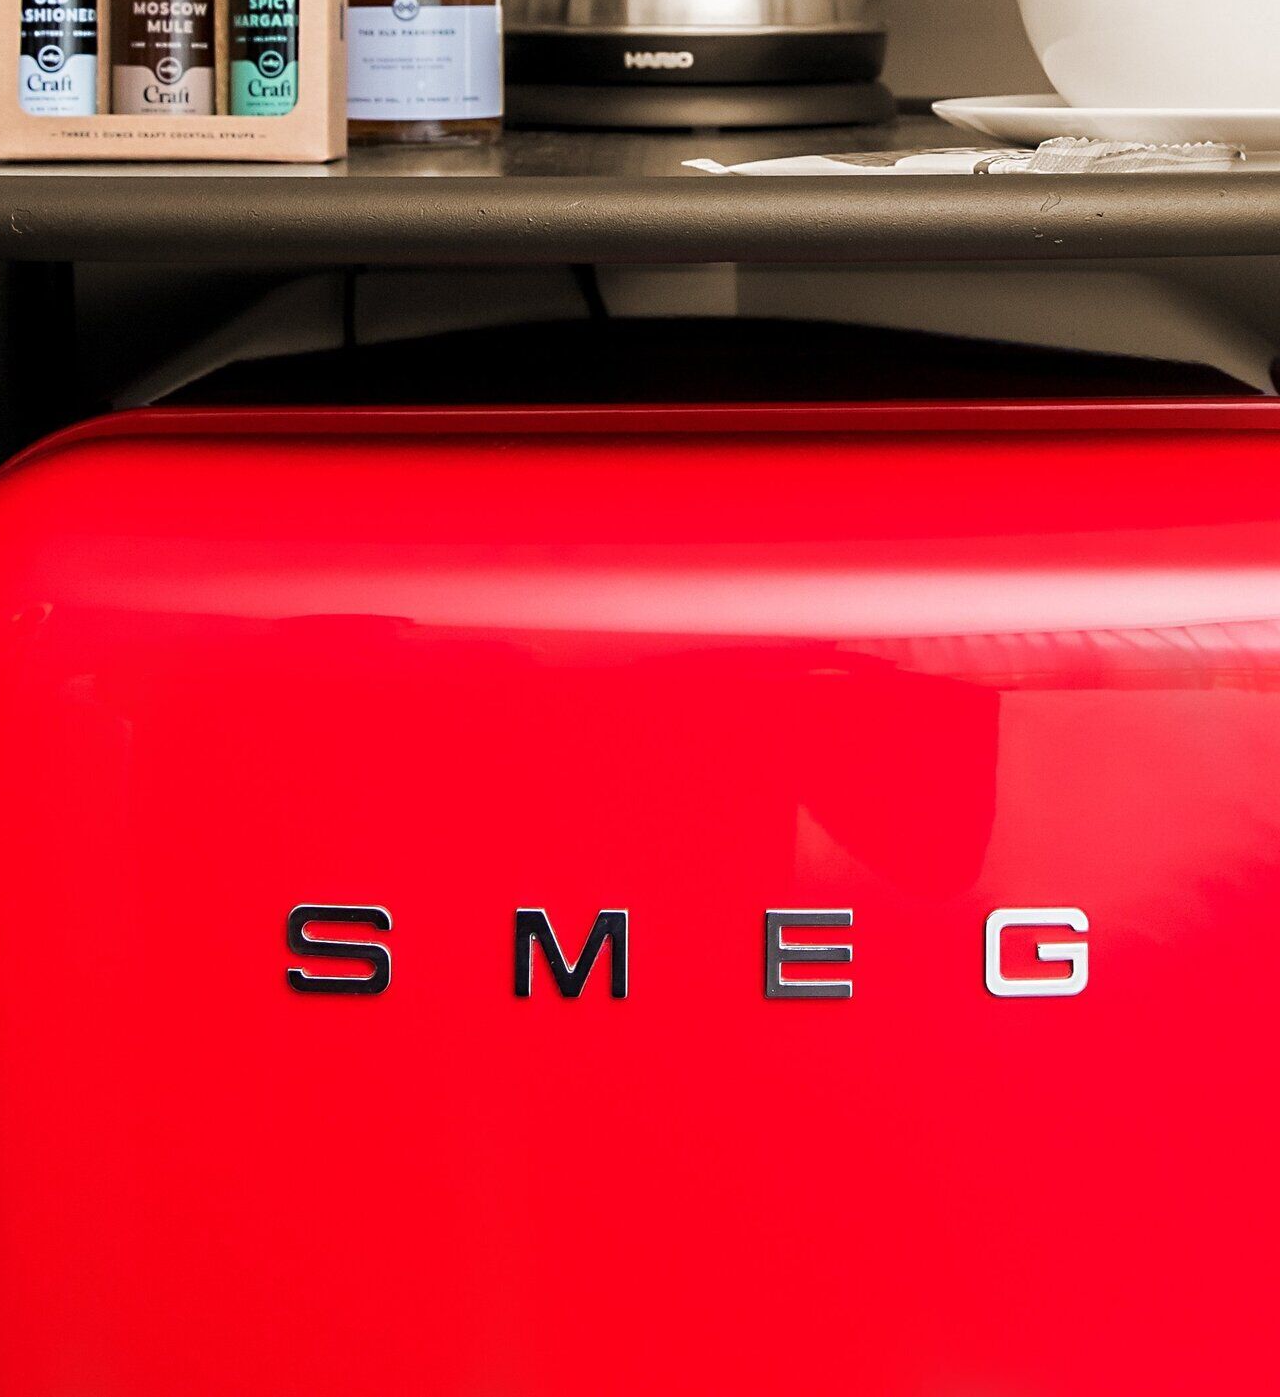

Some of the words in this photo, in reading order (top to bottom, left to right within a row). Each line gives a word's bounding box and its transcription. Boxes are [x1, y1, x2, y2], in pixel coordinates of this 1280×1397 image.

[133, 2, 208, 16] MOSCOW
[147, 20, 194, 34] MULE
[27, 73, 72, 92] Craft
[248, 78, 291, 98] Craft
[143, 85, 190, 104] Craft
[286, 903, 1090, 998] SMEG
